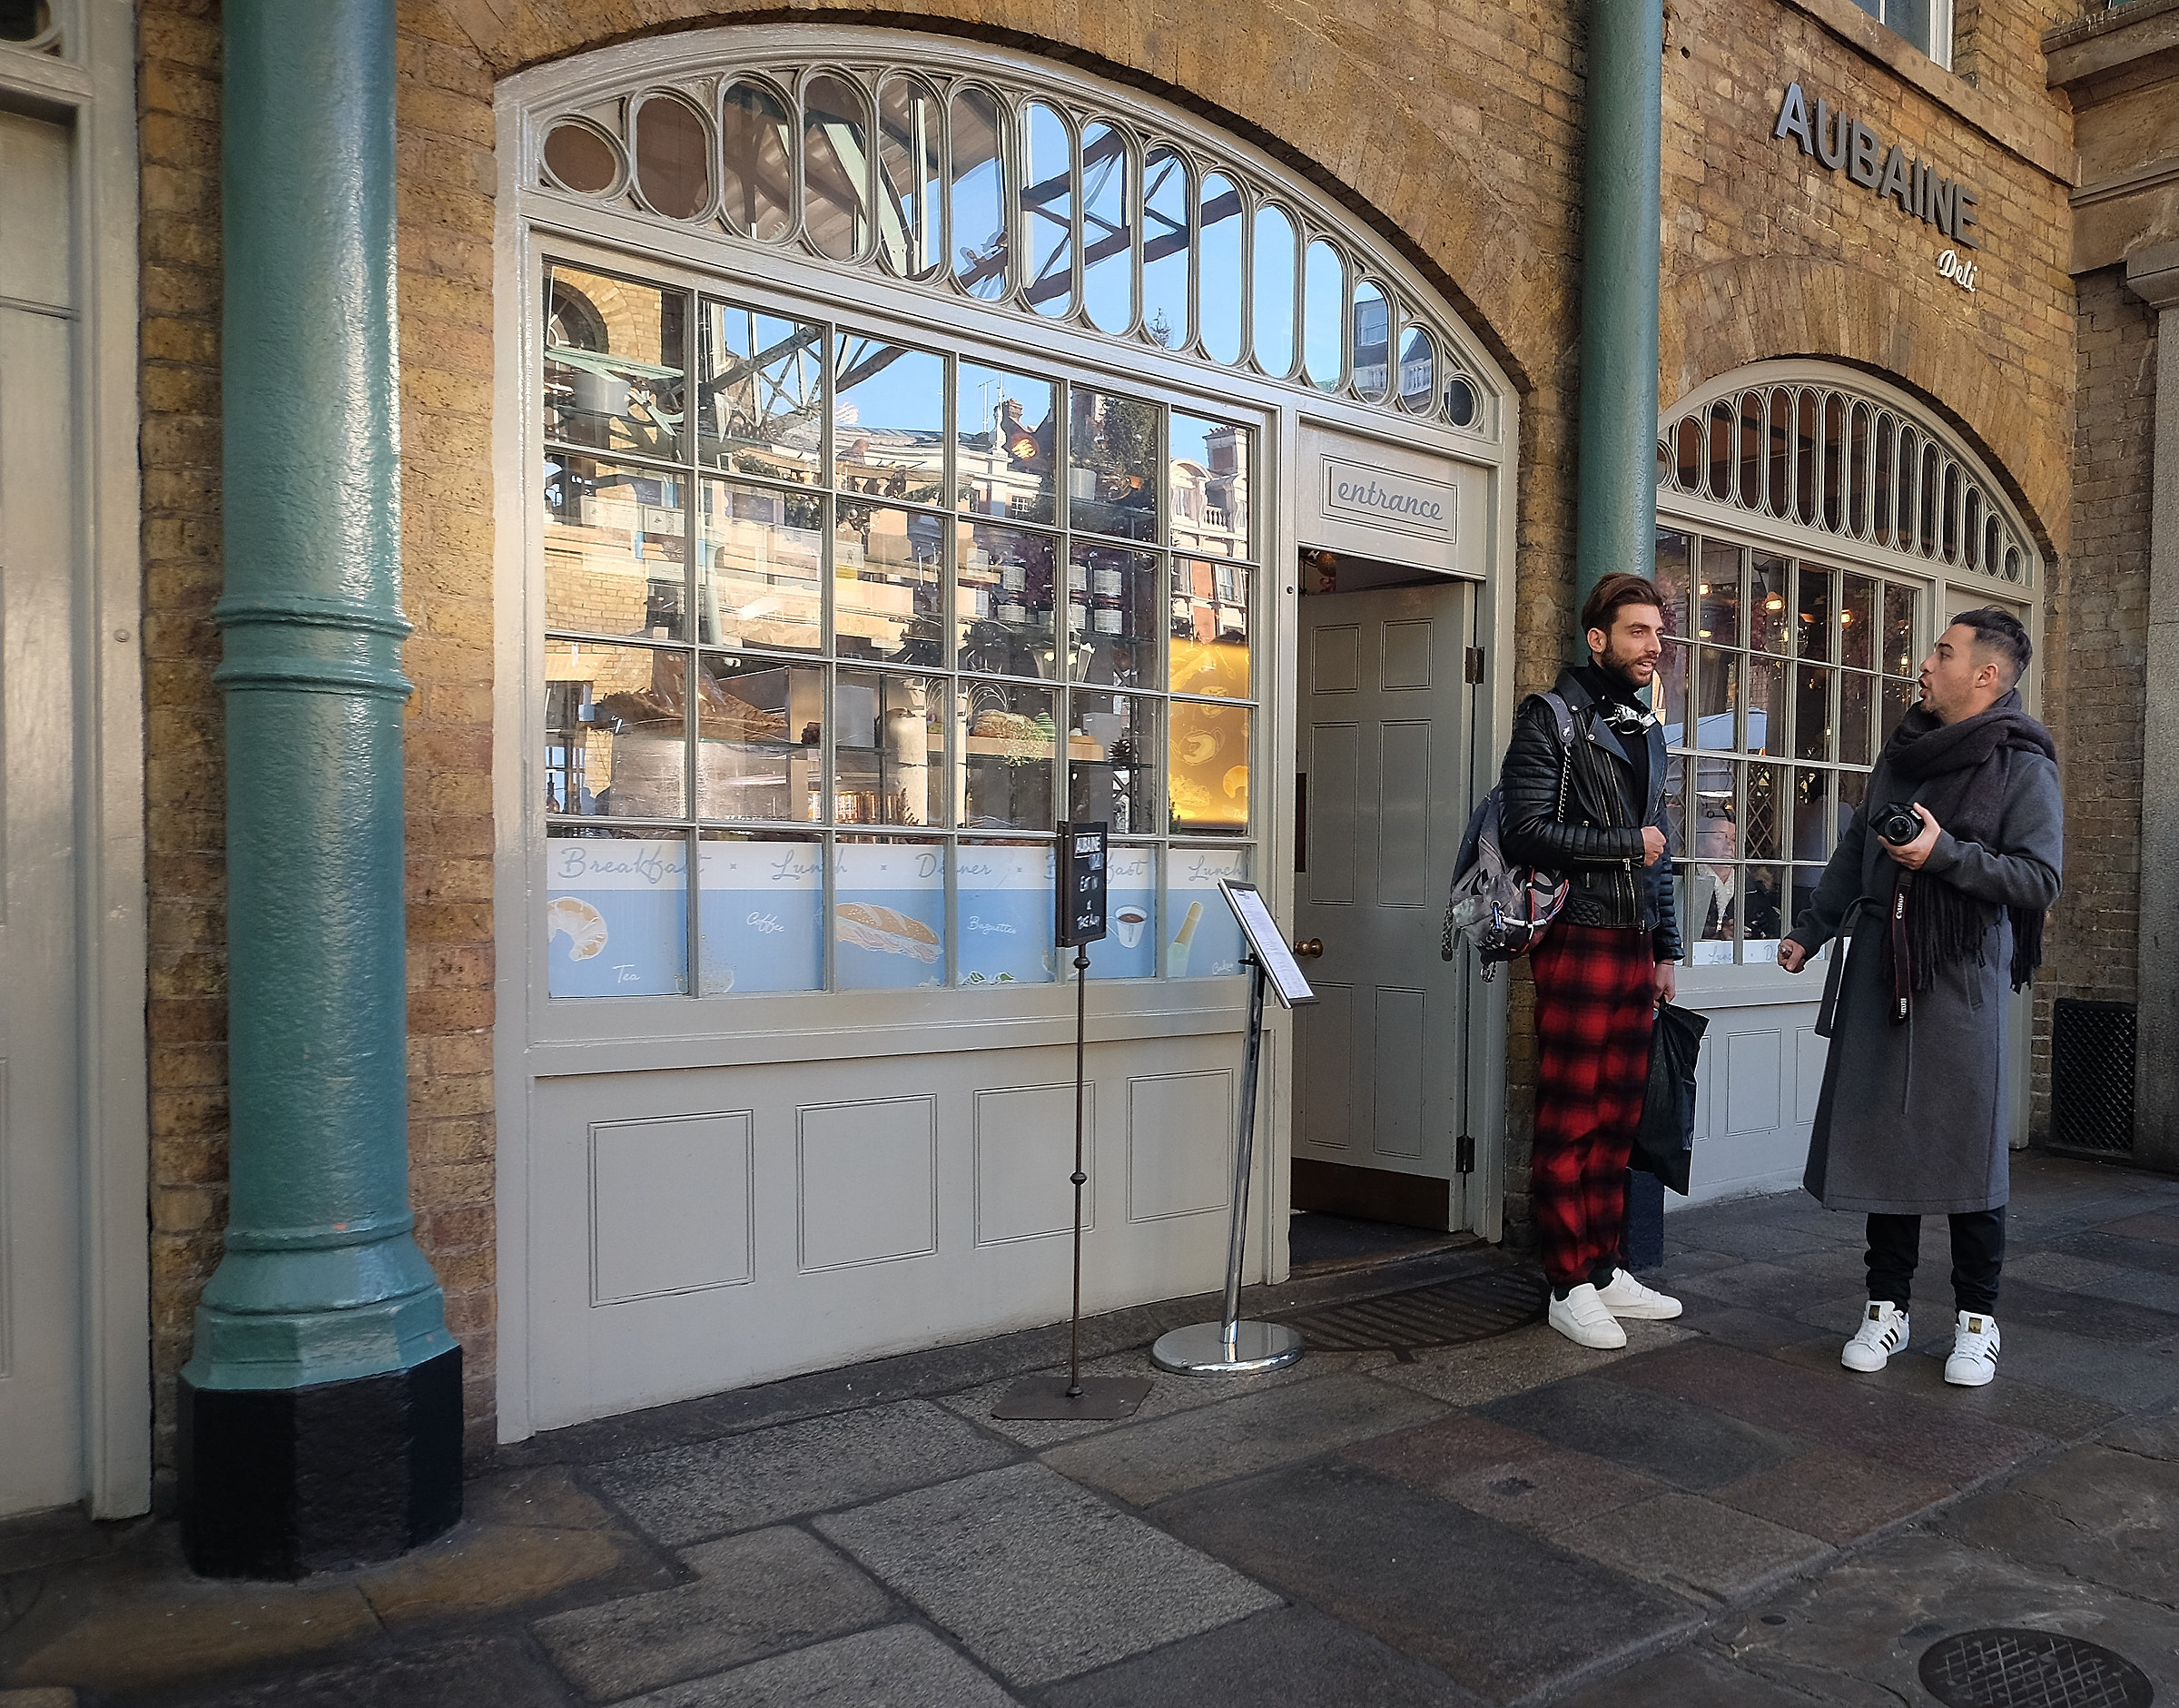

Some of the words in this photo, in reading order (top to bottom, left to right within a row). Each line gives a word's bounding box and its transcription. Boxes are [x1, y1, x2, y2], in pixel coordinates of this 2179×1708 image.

[1774, 81, 1979, 250] AUBAINE
[1937, 250, 1978, 292] Deli
[1337, 481, 1444, 520] entrance
[771, 849, 847, 880] Lunh
[746, 912, 784, 934] Coffee
[612, 963, 641, 983] Tea
